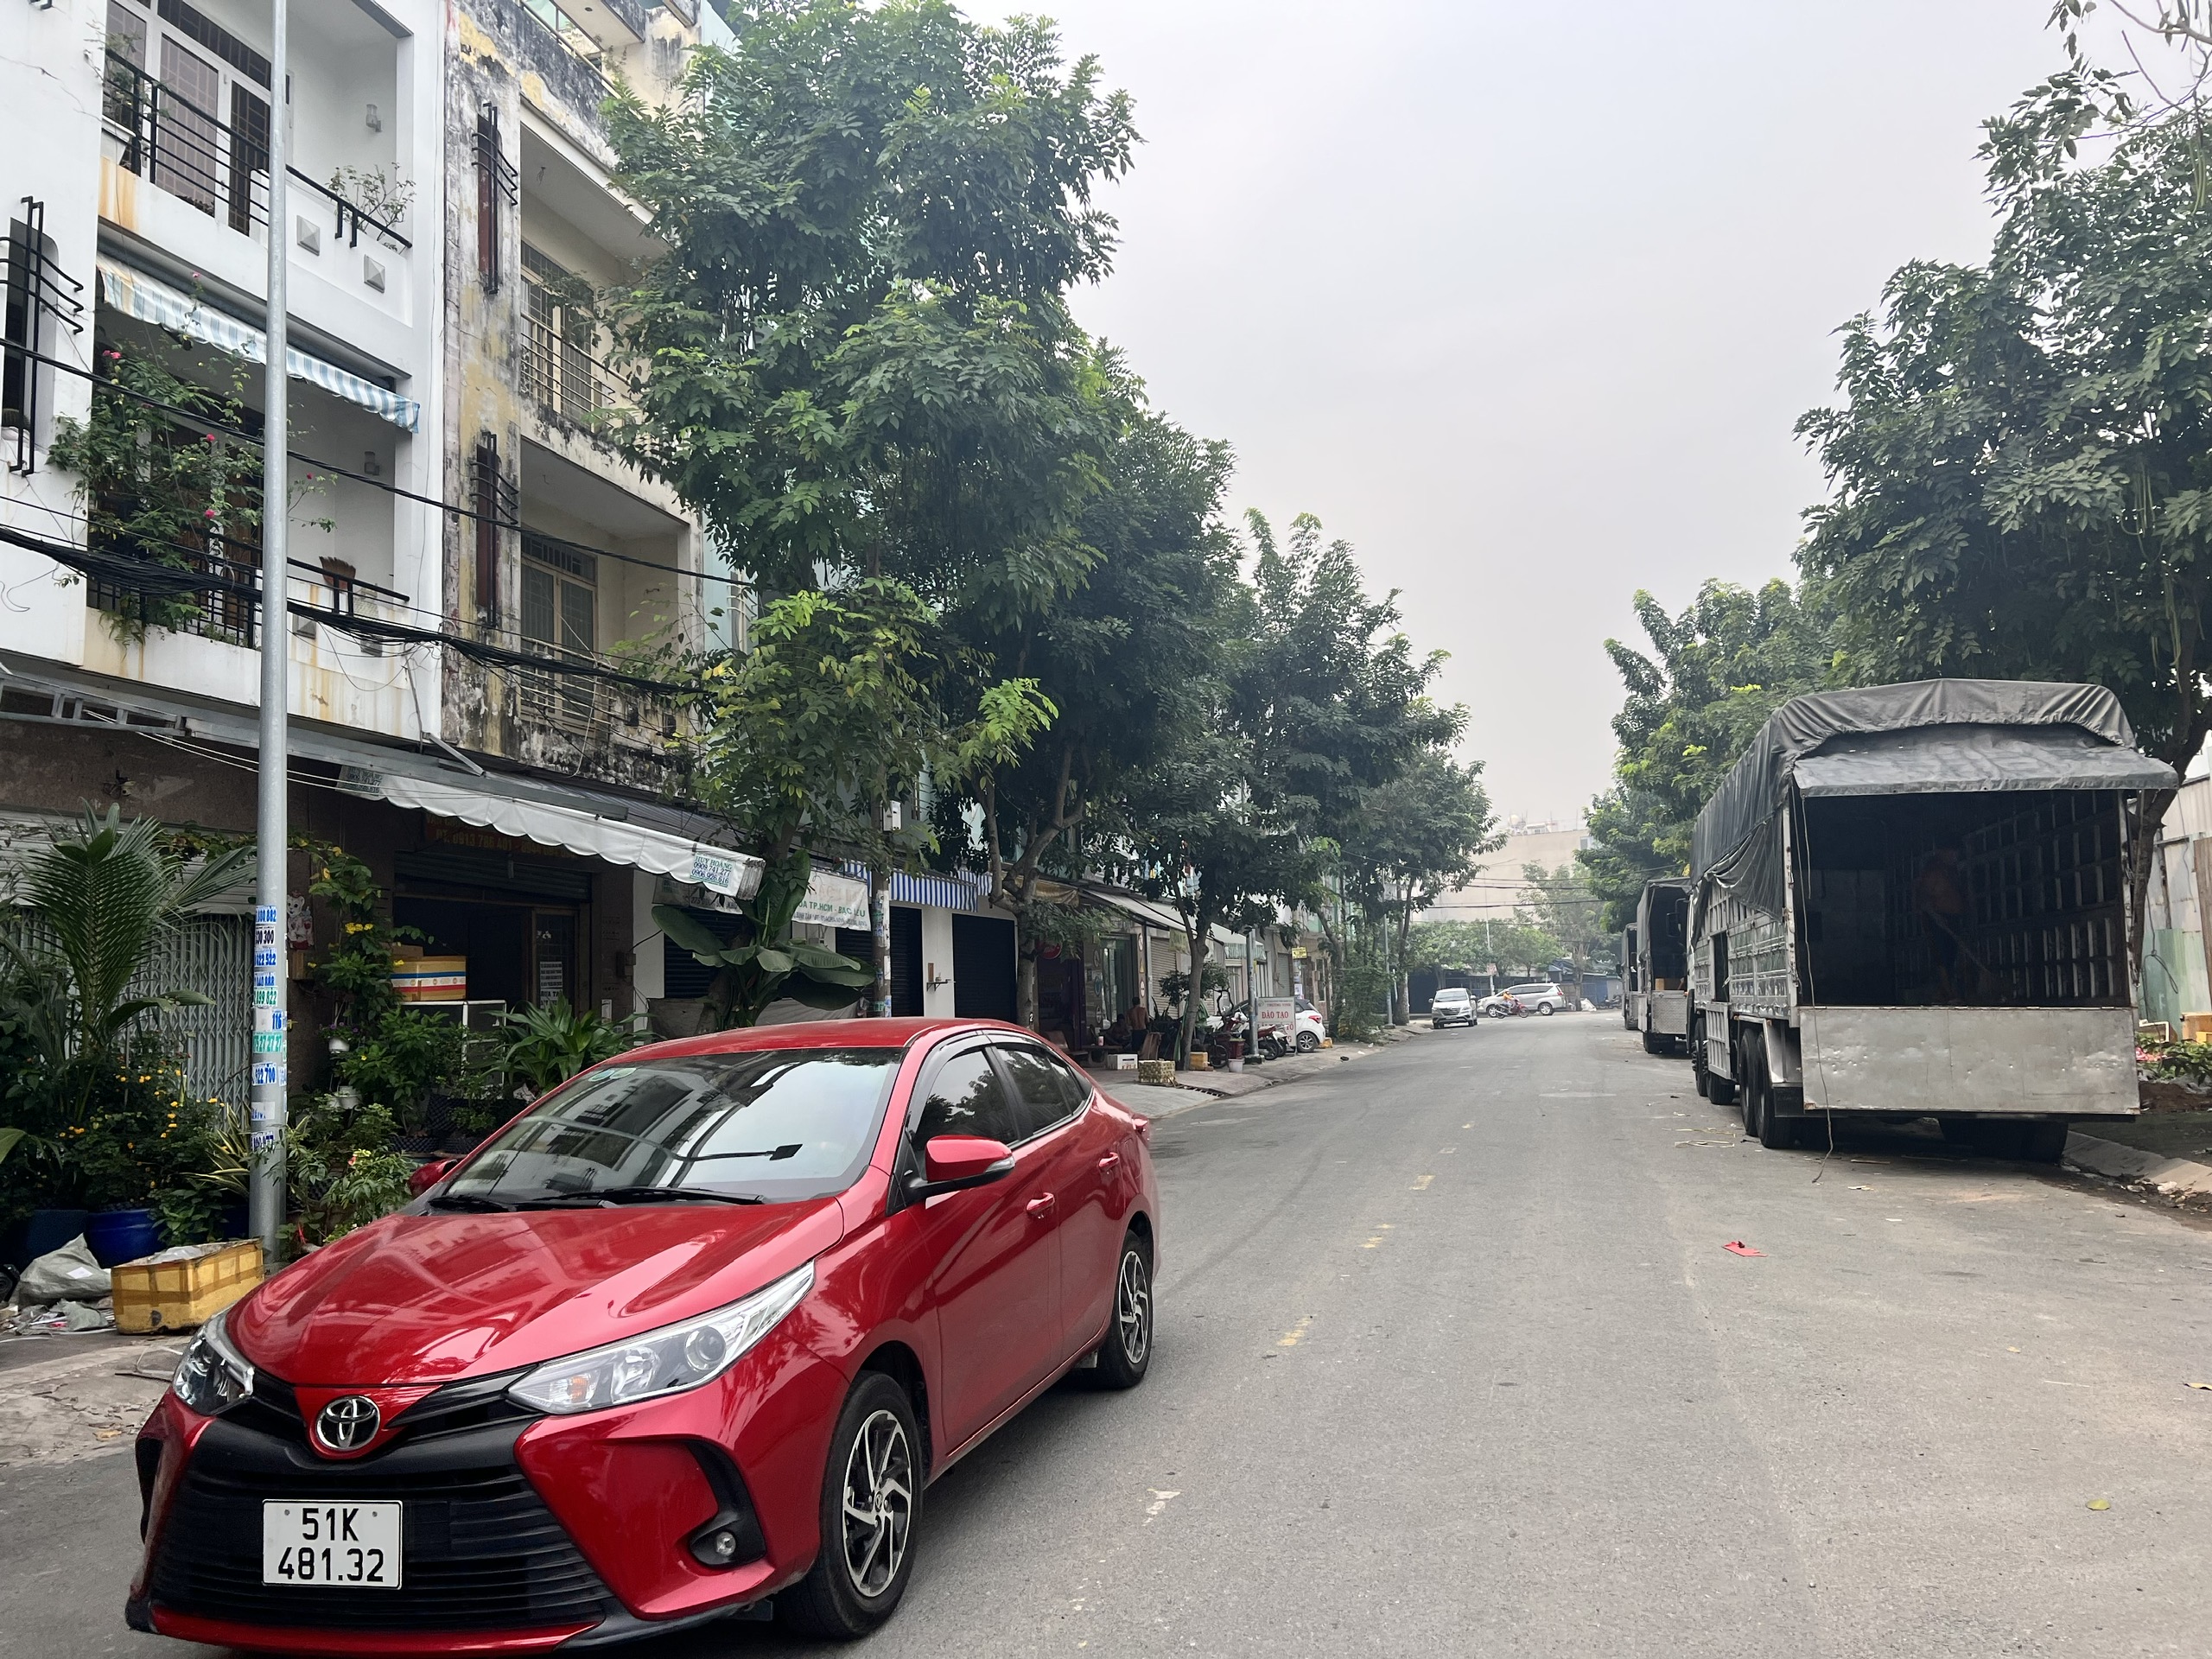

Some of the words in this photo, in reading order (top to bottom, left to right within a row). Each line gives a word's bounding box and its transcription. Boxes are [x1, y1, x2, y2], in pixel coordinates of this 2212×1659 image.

[695, 855, 709, 864] HUY
[707, 872, 718, 881] 926
[709, 865, 719, 874] 741
[720, 868, 732, 878] 277
[809, 901, 833, 912] TP.HCM
[837, 906, 852, 917] BẠC
[1262, 1010, 1274, 1019] ĐÀO
[264, 1066, 276, 1084] 700
[302, 1508, 359, 1541] 51K
[277, 1547, 384, 1582] 481.32
